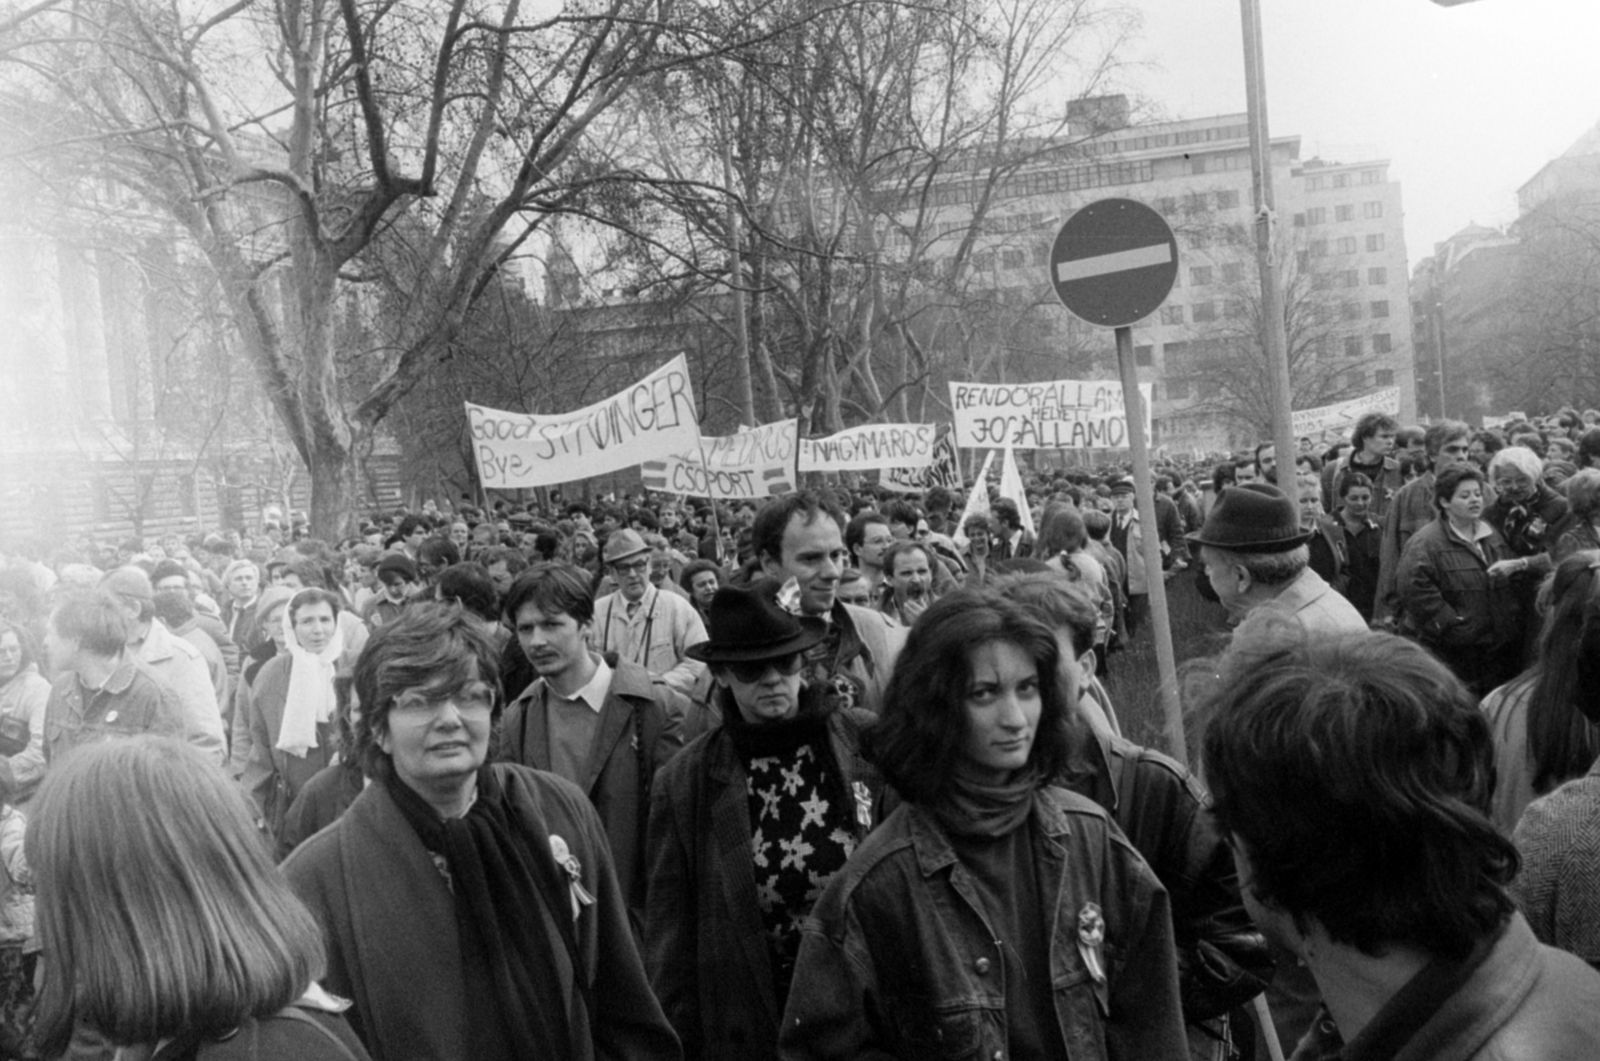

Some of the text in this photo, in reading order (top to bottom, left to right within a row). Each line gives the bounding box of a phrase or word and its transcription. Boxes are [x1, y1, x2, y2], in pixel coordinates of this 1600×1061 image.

[1031, 404, 1091, 422] HELYETT
[813, 426, 929, 463] NAGYMAROS
[673, 463, 754, 497] CSOPORT
